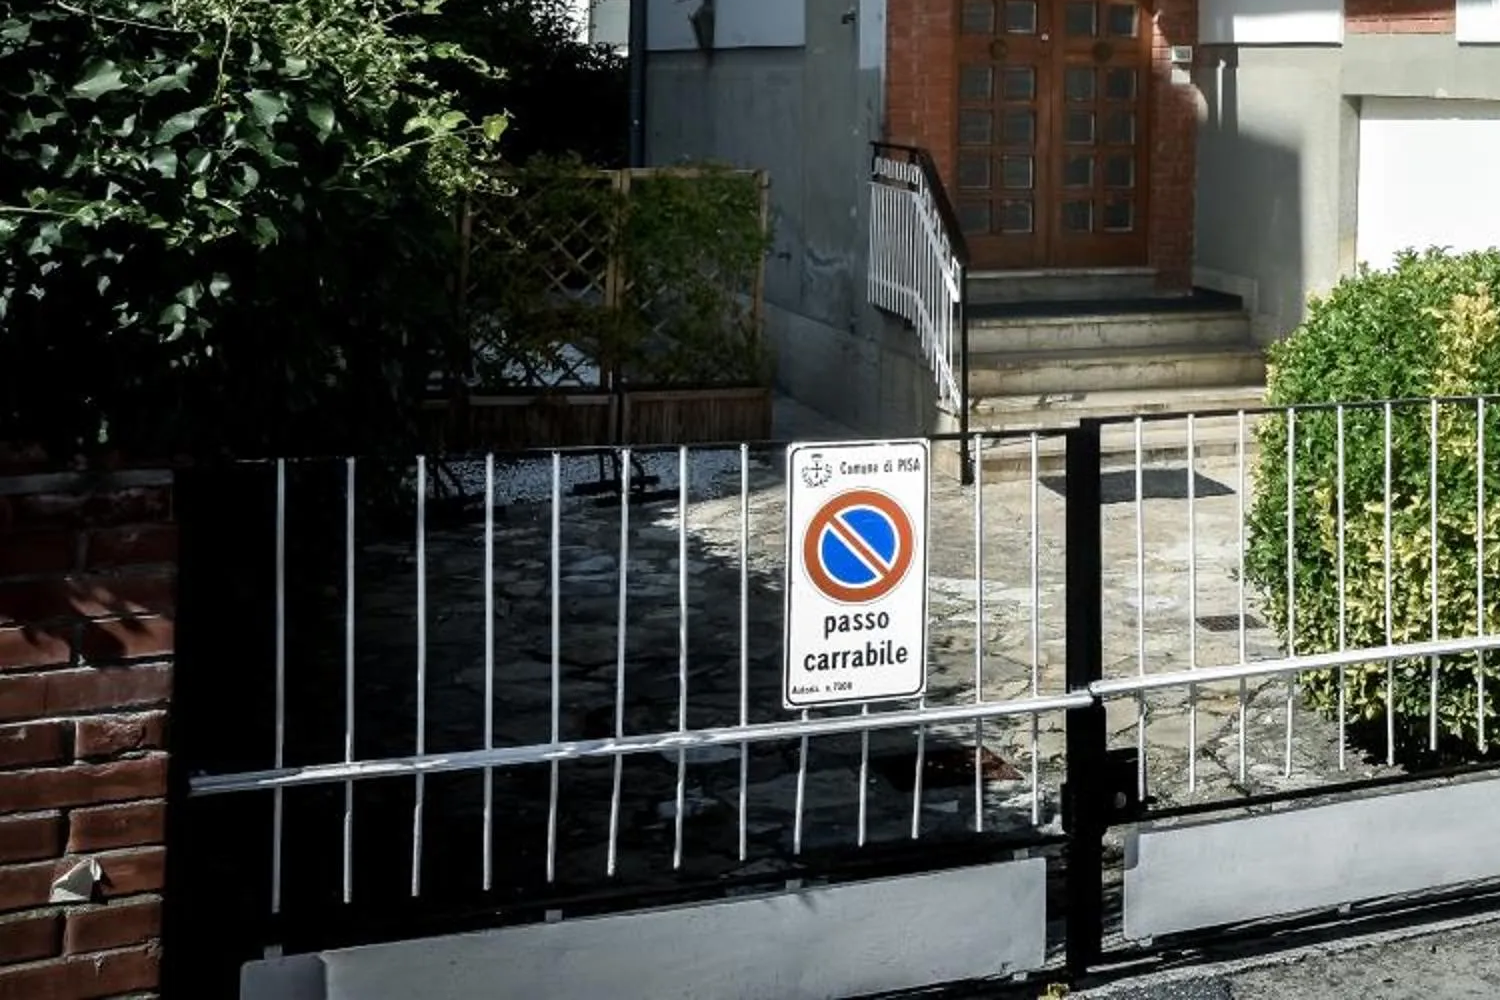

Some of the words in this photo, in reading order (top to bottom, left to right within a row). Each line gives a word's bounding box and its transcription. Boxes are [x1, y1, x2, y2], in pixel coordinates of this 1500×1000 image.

[897, 457, 921, 473] PISA
[823, 611, 890, 640] passo
[803, 639, 909, 673] carrabile
